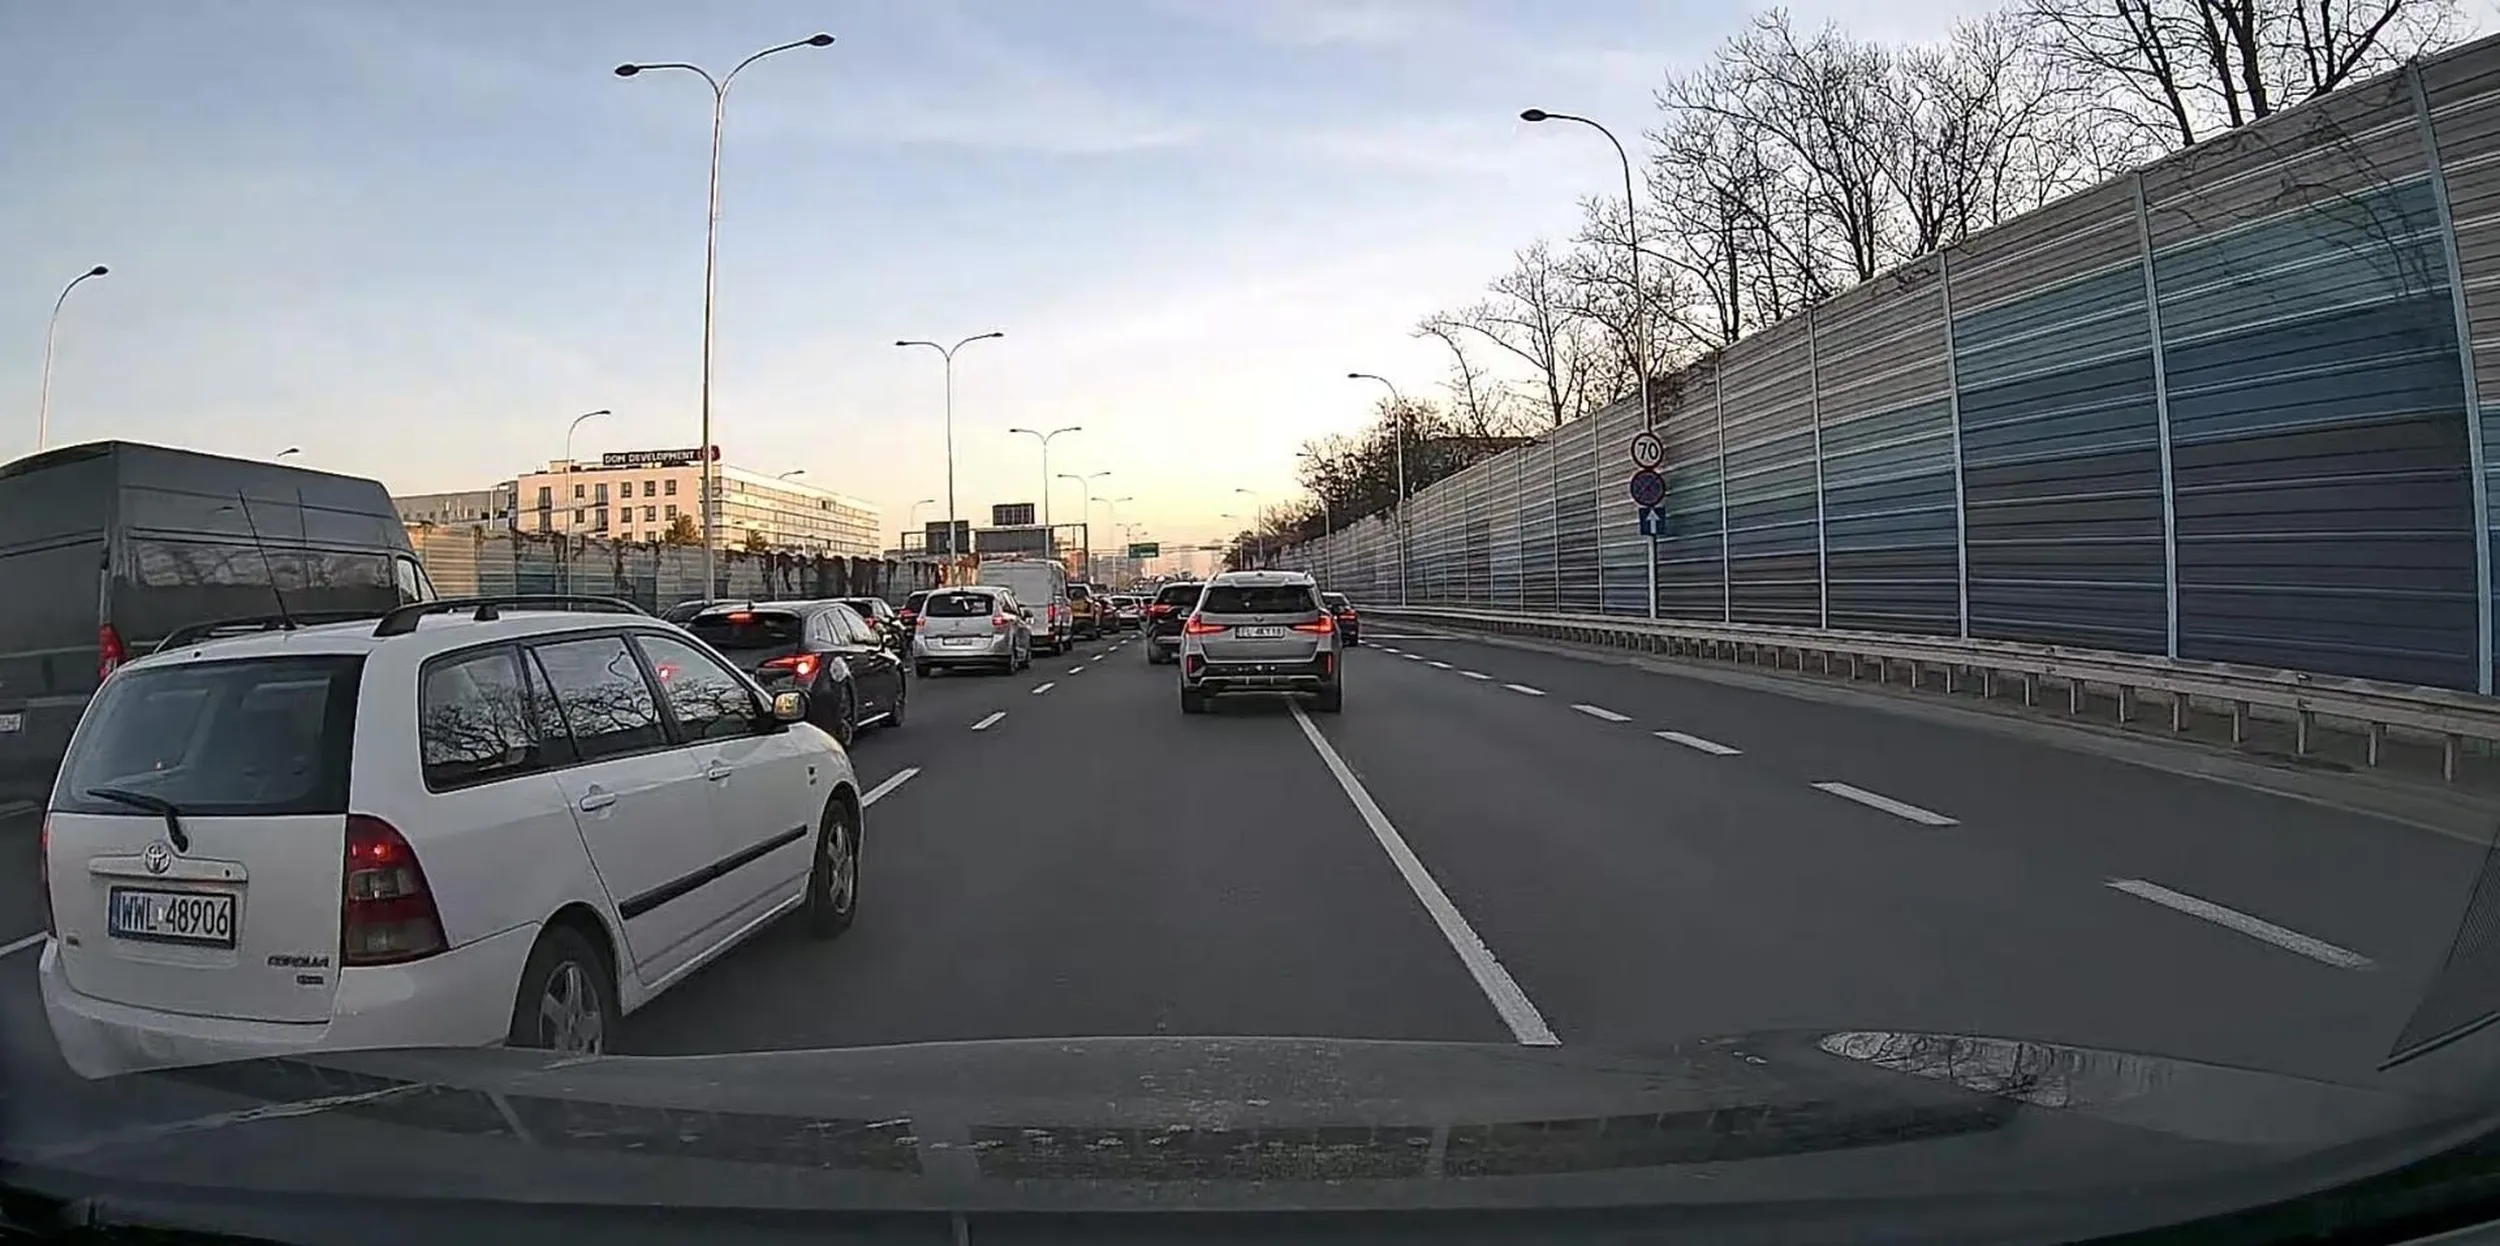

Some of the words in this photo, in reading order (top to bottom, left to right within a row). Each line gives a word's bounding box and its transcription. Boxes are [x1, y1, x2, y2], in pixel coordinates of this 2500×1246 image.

[604, 454, 626, 464] DOM
[628, 451, 695, 463] DEVELOPMENT
[1638, 442, 1659, 460] 70
[121, 895, 157, 931] WWL
[165, 897, 229, 936] 48906
